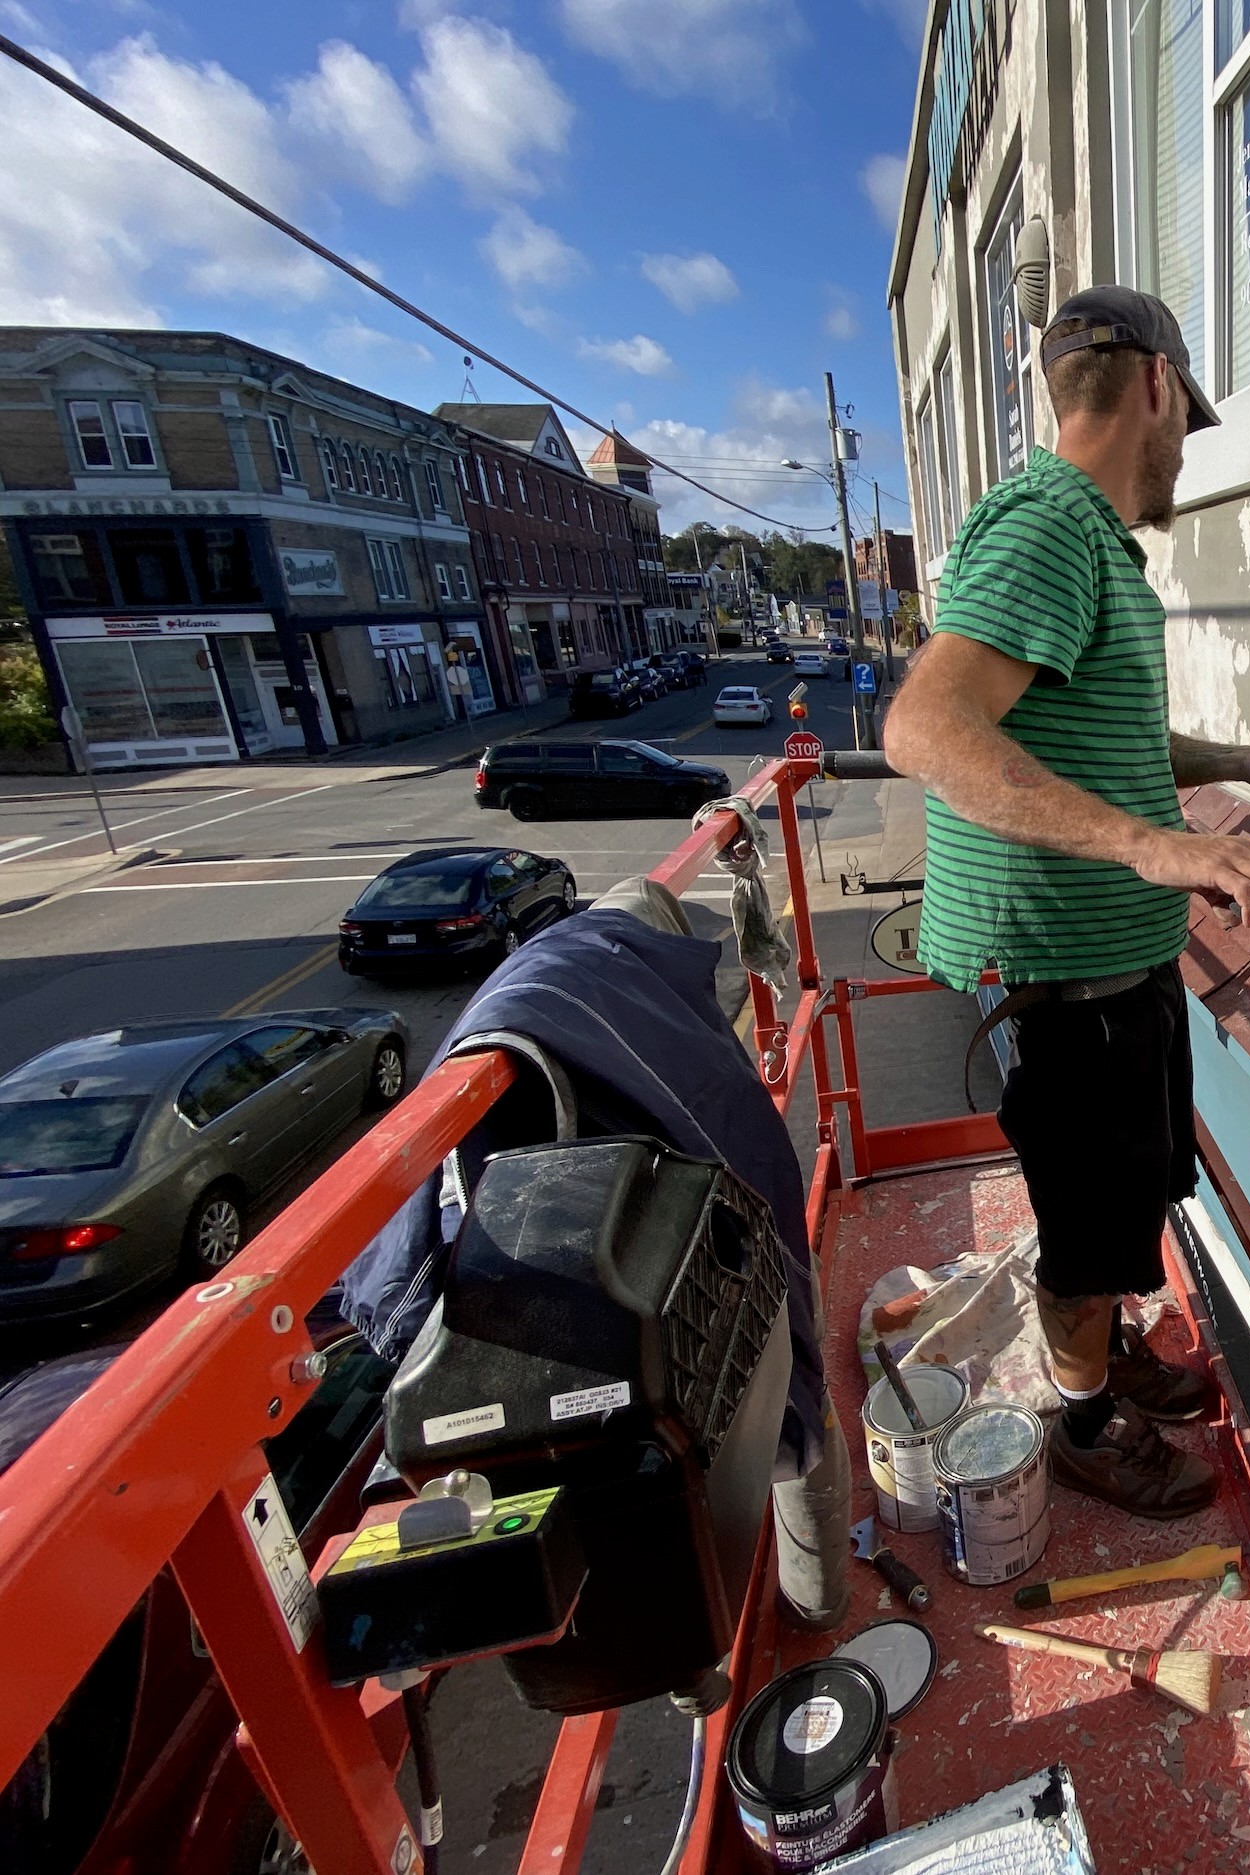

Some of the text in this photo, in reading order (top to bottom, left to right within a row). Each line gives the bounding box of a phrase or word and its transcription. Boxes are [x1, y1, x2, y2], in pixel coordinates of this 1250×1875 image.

[174, 617, 220, 630] Atlantic
[788, 742, 821, 757] STOP
[775, 1809, 814, 1825] BEHR
[778, 1809, 833, 1833] PREMIUM
[775, 1836, 820, 1849] PEINTURE
[813, 1836, 848, 1860] BRIQUE
[776, 1847, 803, 1857] POUR
